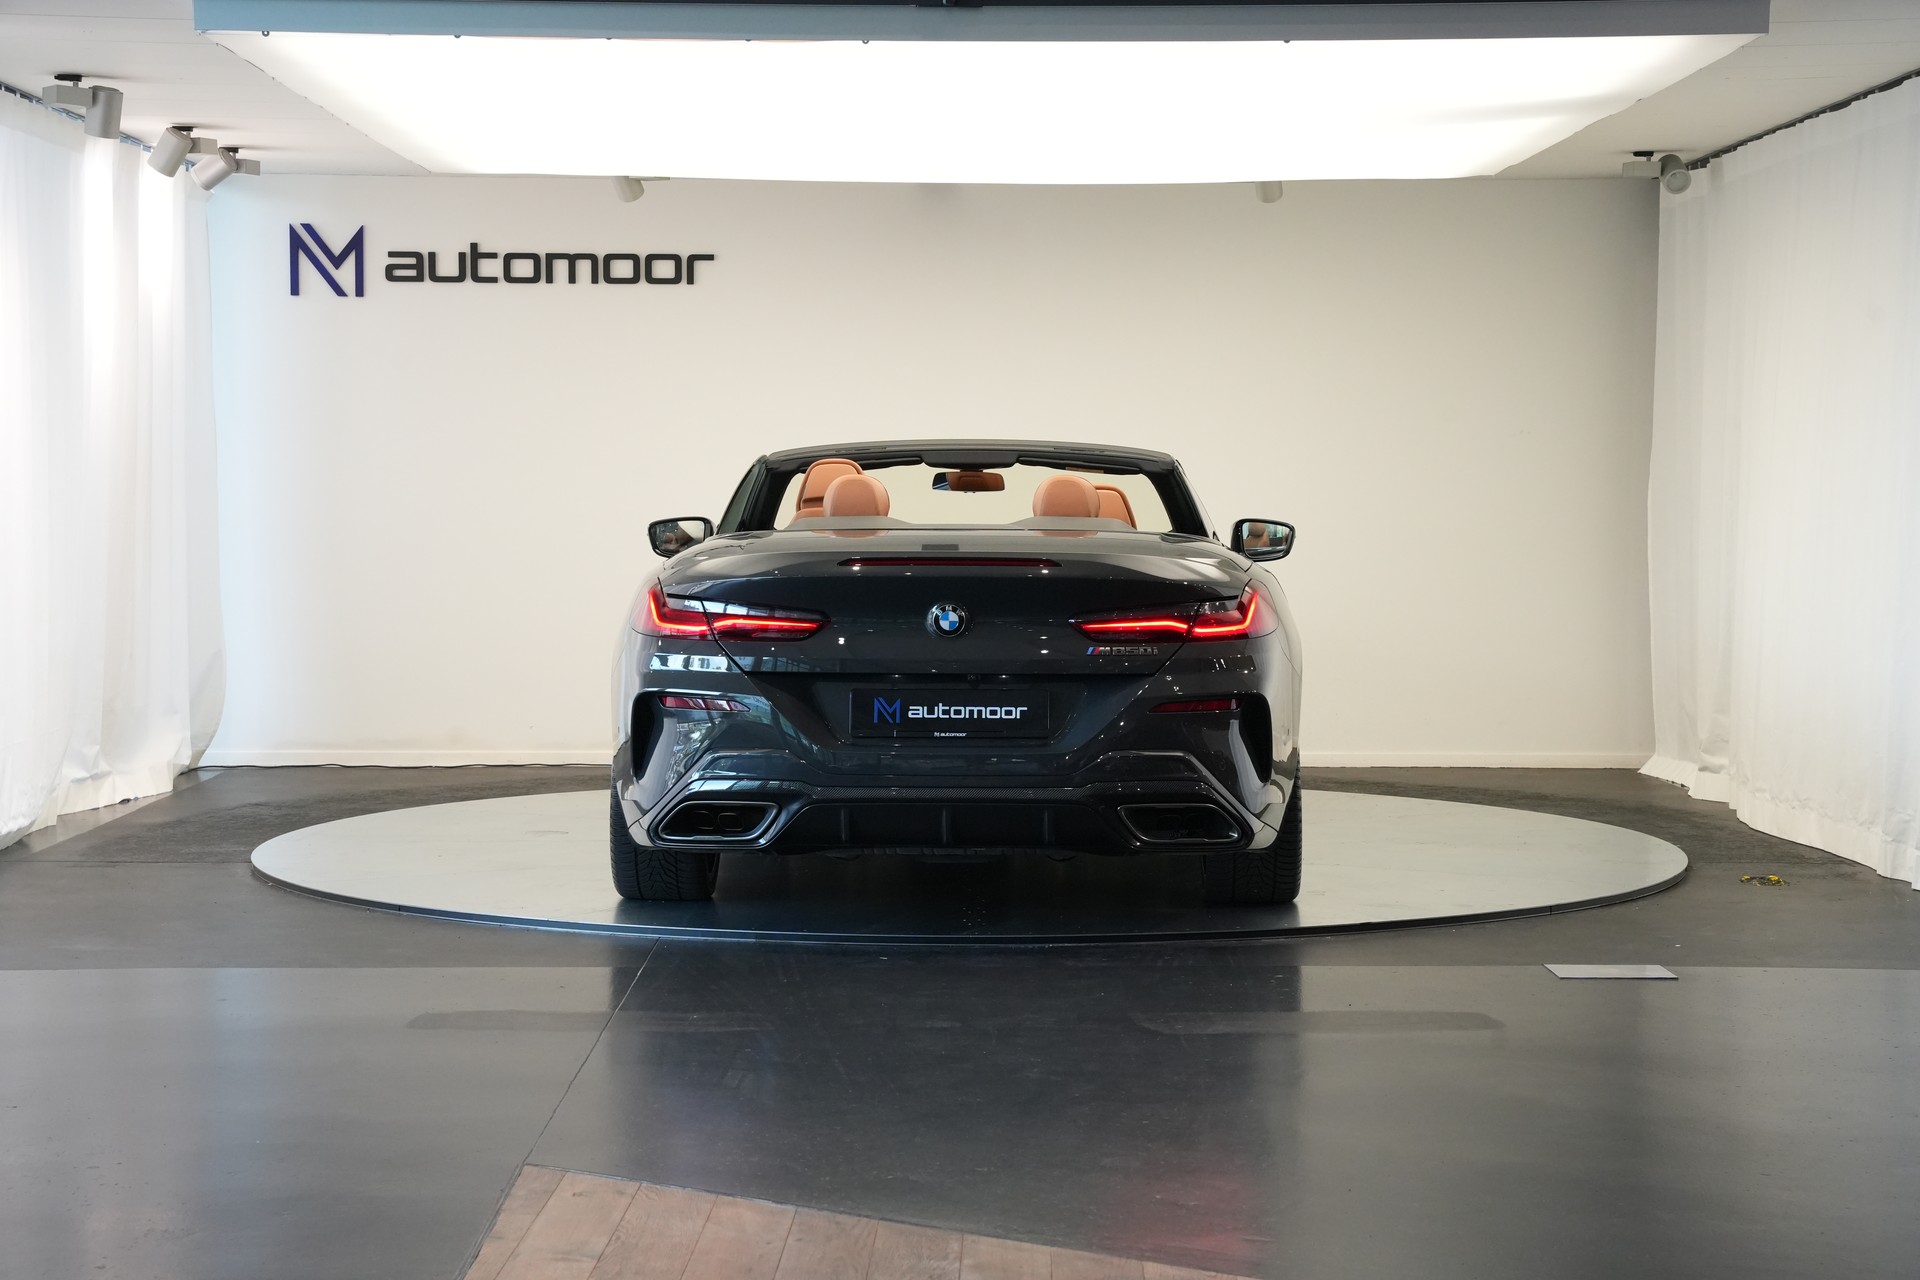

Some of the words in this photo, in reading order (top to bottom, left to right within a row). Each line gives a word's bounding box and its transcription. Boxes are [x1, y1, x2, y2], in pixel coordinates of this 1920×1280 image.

[385, 243, 715, 285] automoor
[935, 605, 965, 616] BMW
[908, 703, 1028, 719] automoor
